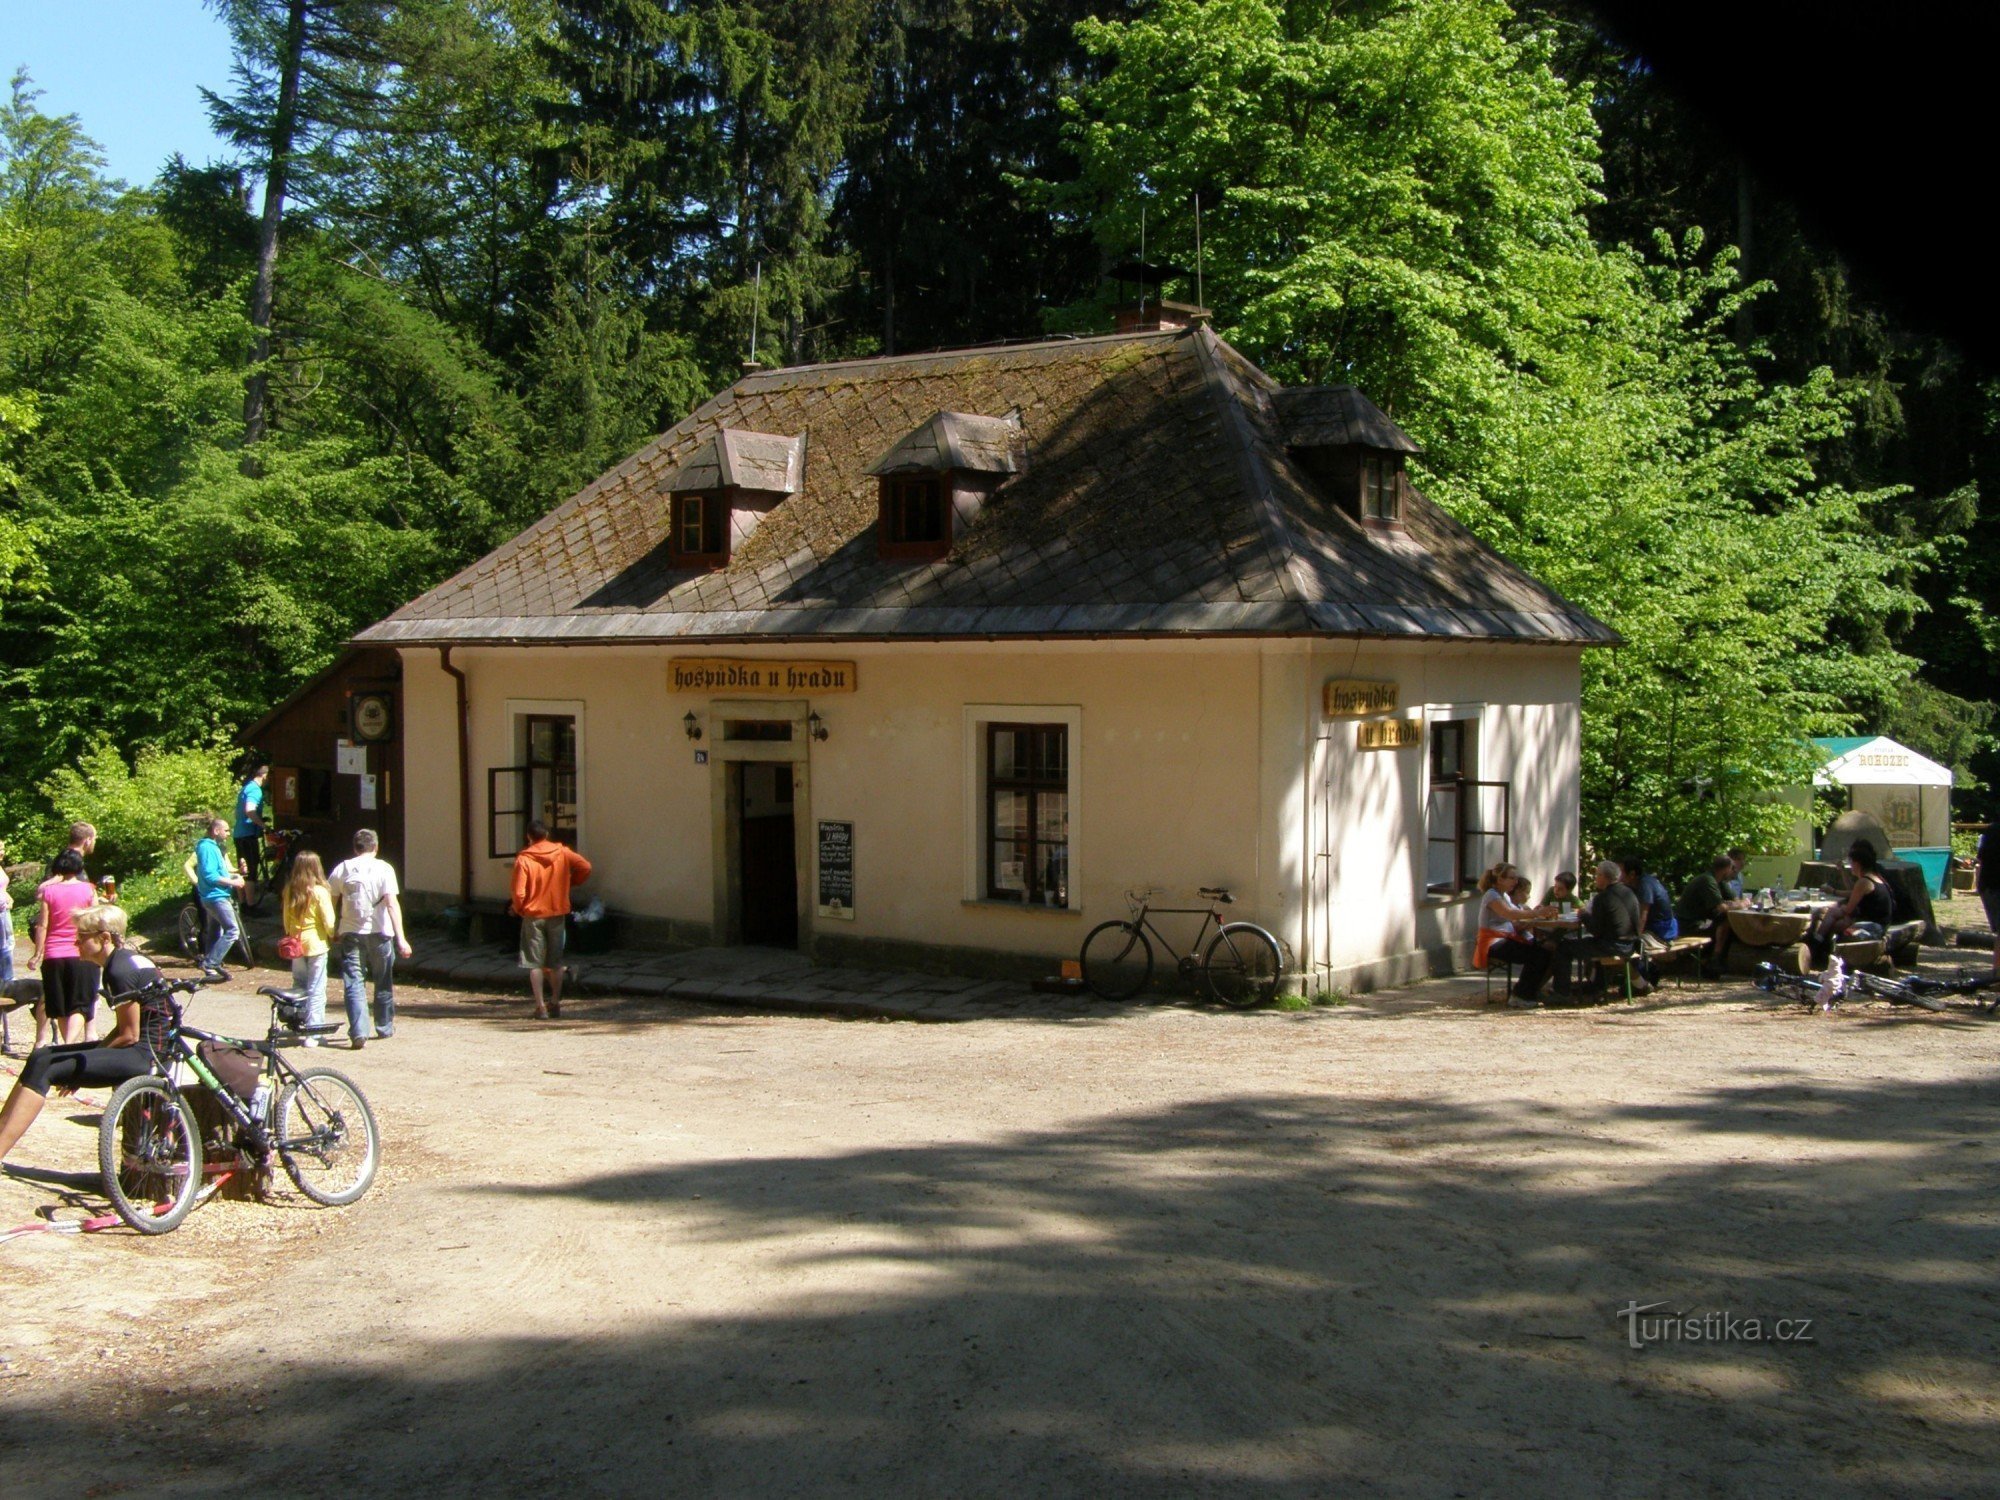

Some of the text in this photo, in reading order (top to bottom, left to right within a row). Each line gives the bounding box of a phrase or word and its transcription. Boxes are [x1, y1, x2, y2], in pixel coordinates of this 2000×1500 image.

[674, 664, 846, 692] hospůdka u hradu
[1365, 720, 1419, 745] u hradu
[1858, 754, 1909, 767] ROHOZEC
